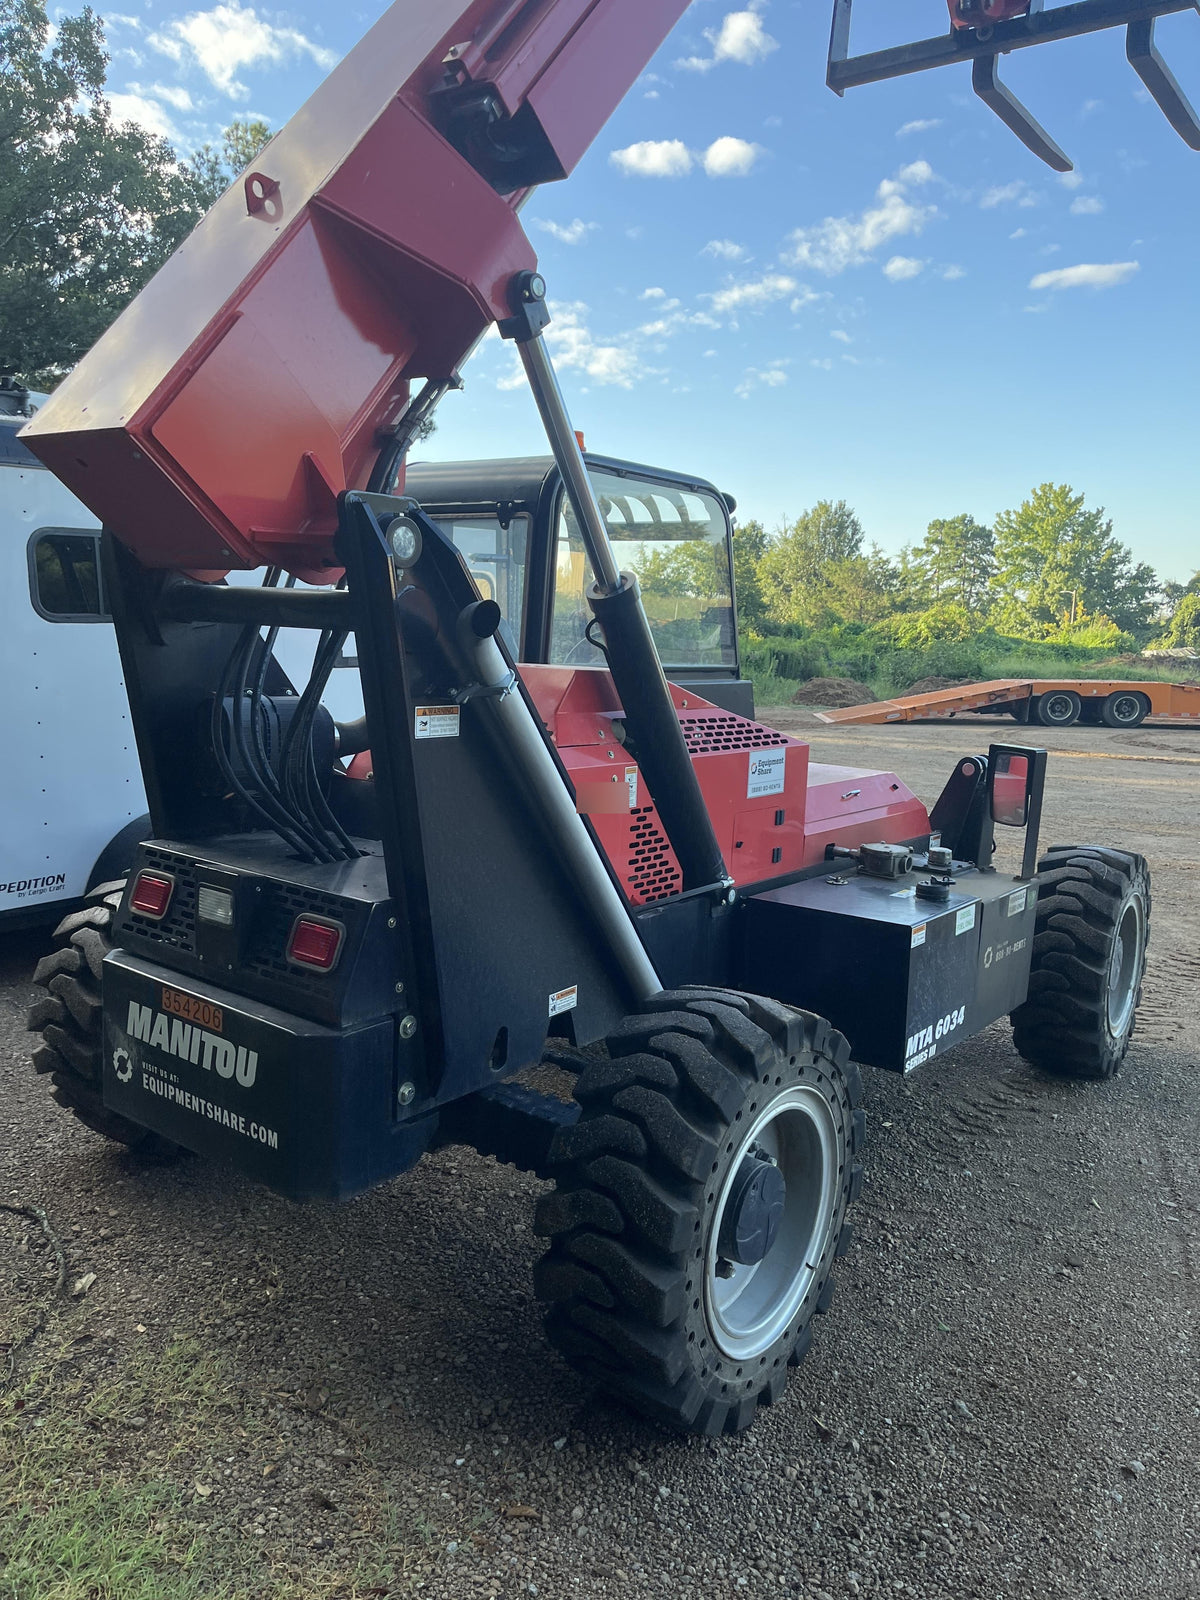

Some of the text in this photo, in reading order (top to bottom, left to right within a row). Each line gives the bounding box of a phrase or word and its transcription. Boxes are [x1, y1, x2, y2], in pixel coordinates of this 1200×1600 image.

[757, 768, 772, 776] Share
[758, 757, 784, 768] Equipment
[0, 873, 66, 893] PEDITION
[164, 989, 221, 1028] 354206
[127, 1000, 259, 1088] MANITOU
[905, 1005, 965, 1059] MTA 6034
[142, 1061, 179, 1083] VISIT US AT:
[904, 1049, 928, 1073] SERIES
[142, 1073, 278, 1149] EQUIPMENTSHARE.COM
